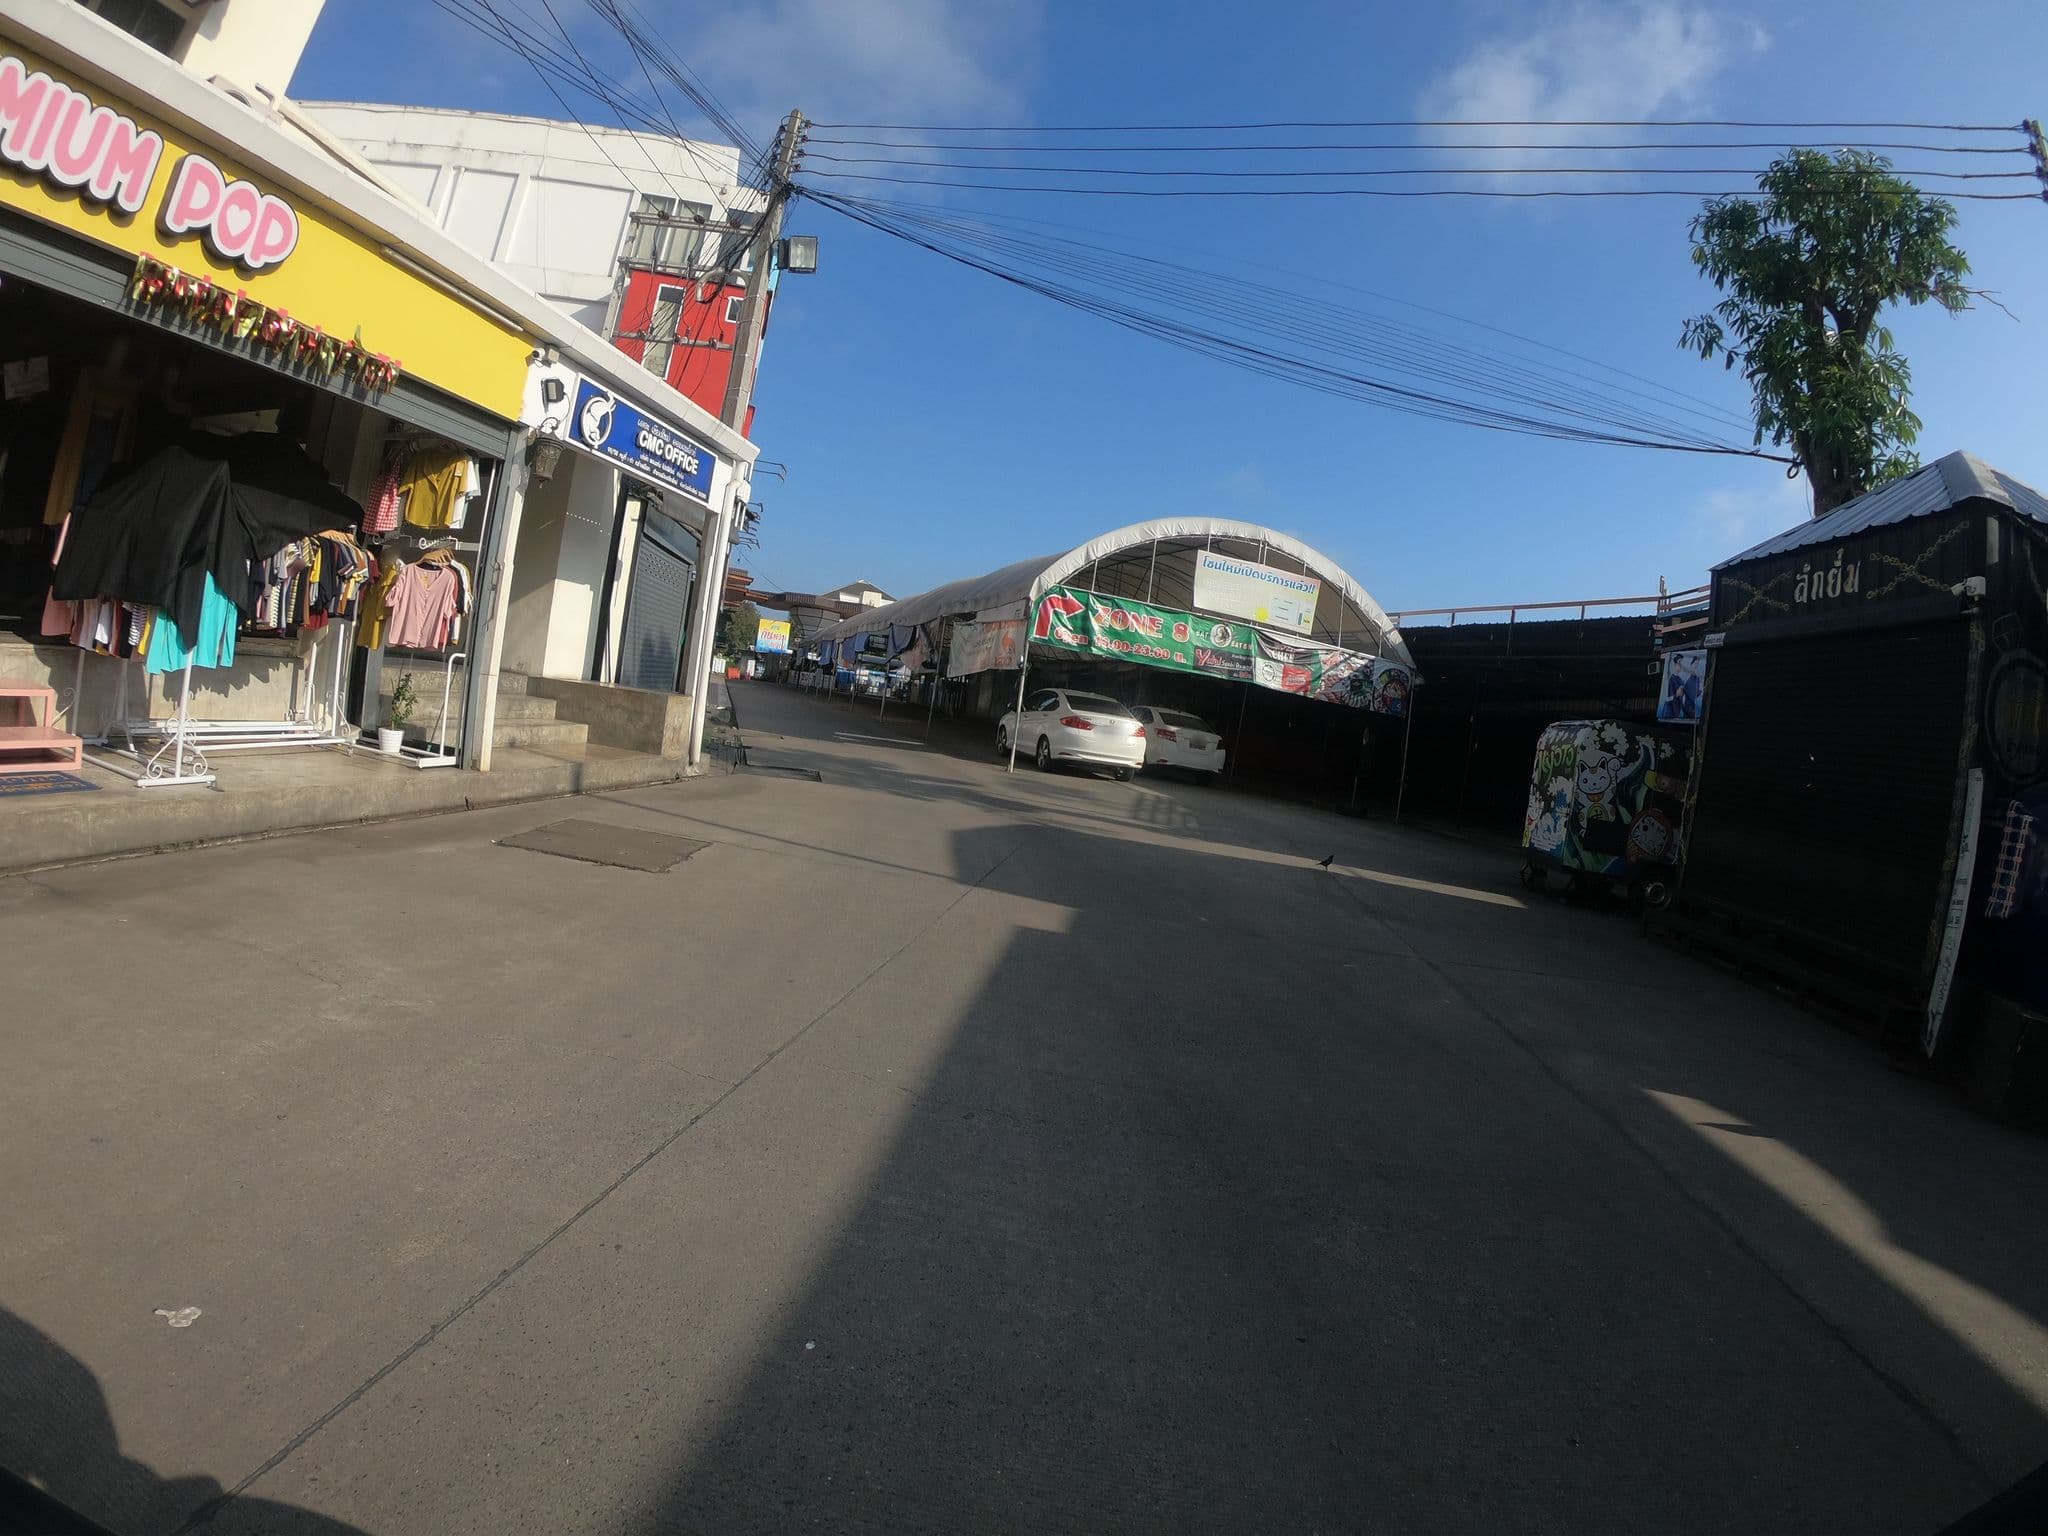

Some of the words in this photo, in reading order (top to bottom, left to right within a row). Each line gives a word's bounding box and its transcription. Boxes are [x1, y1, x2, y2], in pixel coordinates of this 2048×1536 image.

[166, 158, 297, 266] POP
[639, 431, 664, 456] CMC
[664, 444, 699, 475] OFFICE
[1093, 605, 1164, 639] ZONE
[1172, 621, 1190, 643] 8
